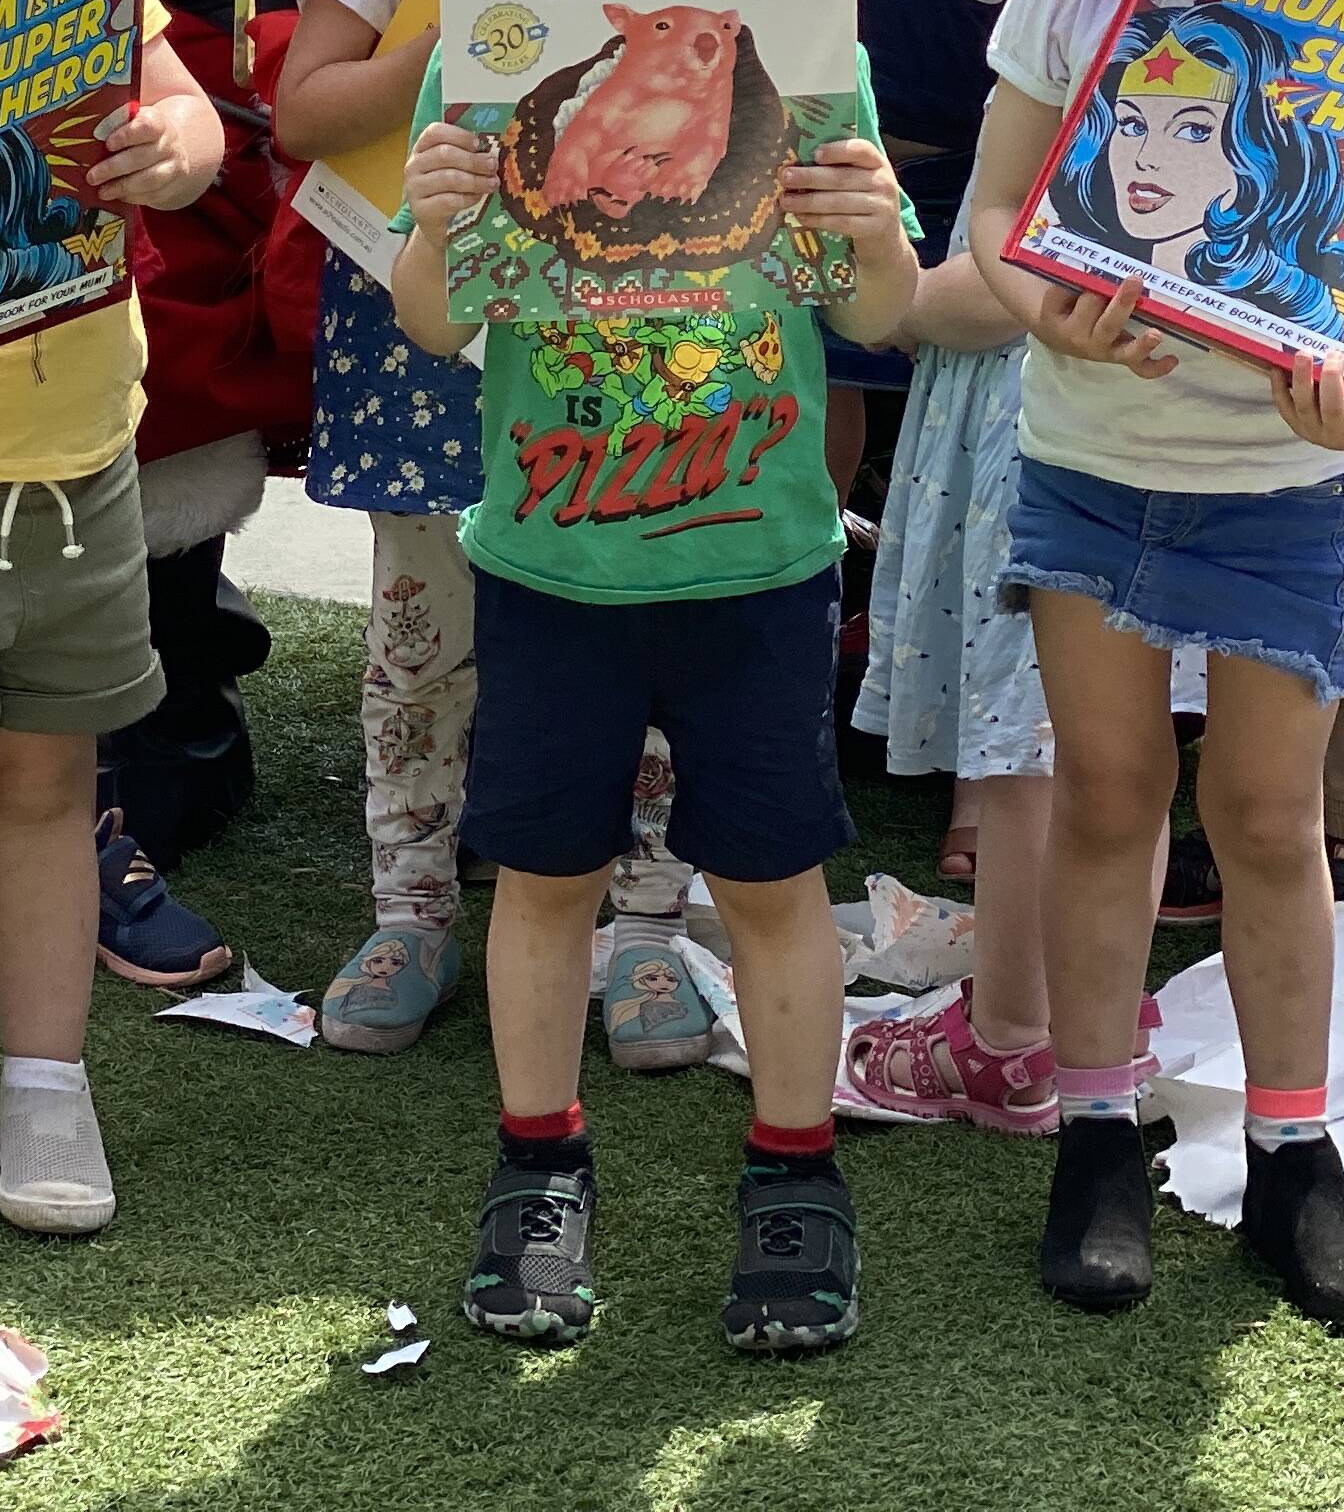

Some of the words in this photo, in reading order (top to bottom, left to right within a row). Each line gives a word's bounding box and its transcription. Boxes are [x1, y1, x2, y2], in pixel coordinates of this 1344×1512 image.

[490, 24, 524, 61] 30
[28, 296, 49, 310] FOR
[51, 285, 75, 302] YOUR
[79, 273, 107, 290] MUM!
[606, 291, 722, 307] SCHOLASTIC
[1051, 235, 1099, 260] CREATE
[1102, 255, 1111, 265] A
[1113, 260, 1159, 285] UNIQUE
[1161, 278, 1226, 313] KEEPSAKE
[1230, 306, 1265, 328] BOOK
[1267, 321, 1293, 338] FOR
[1296, 332, 1336, 353] YOUR
[565, 395, 603, 427] IS
